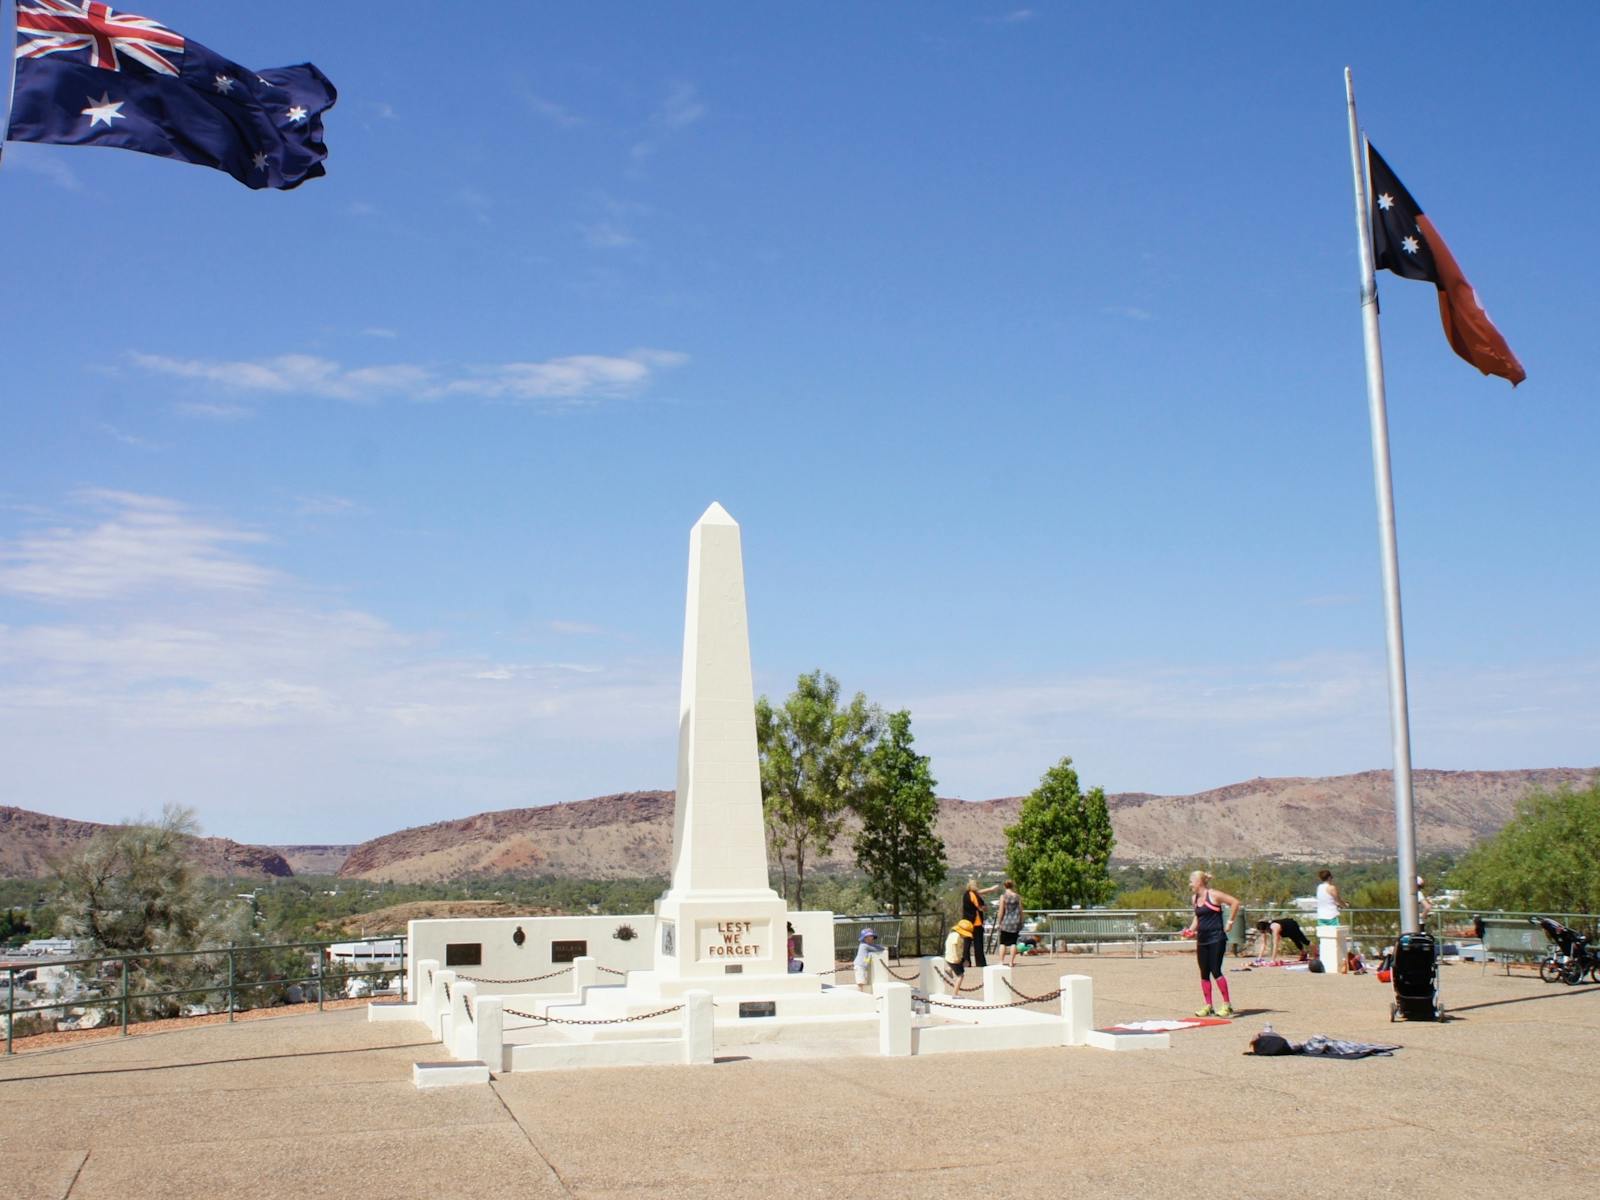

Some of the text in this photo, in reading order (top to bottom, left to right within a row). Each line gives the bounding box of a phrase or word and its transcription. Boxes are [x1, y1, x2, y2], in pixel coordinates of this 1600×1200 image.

[718, 922, 751, 932] LEST
[723, 934, 740, 944] WE
[709, 945, 760, 955] FORGET
